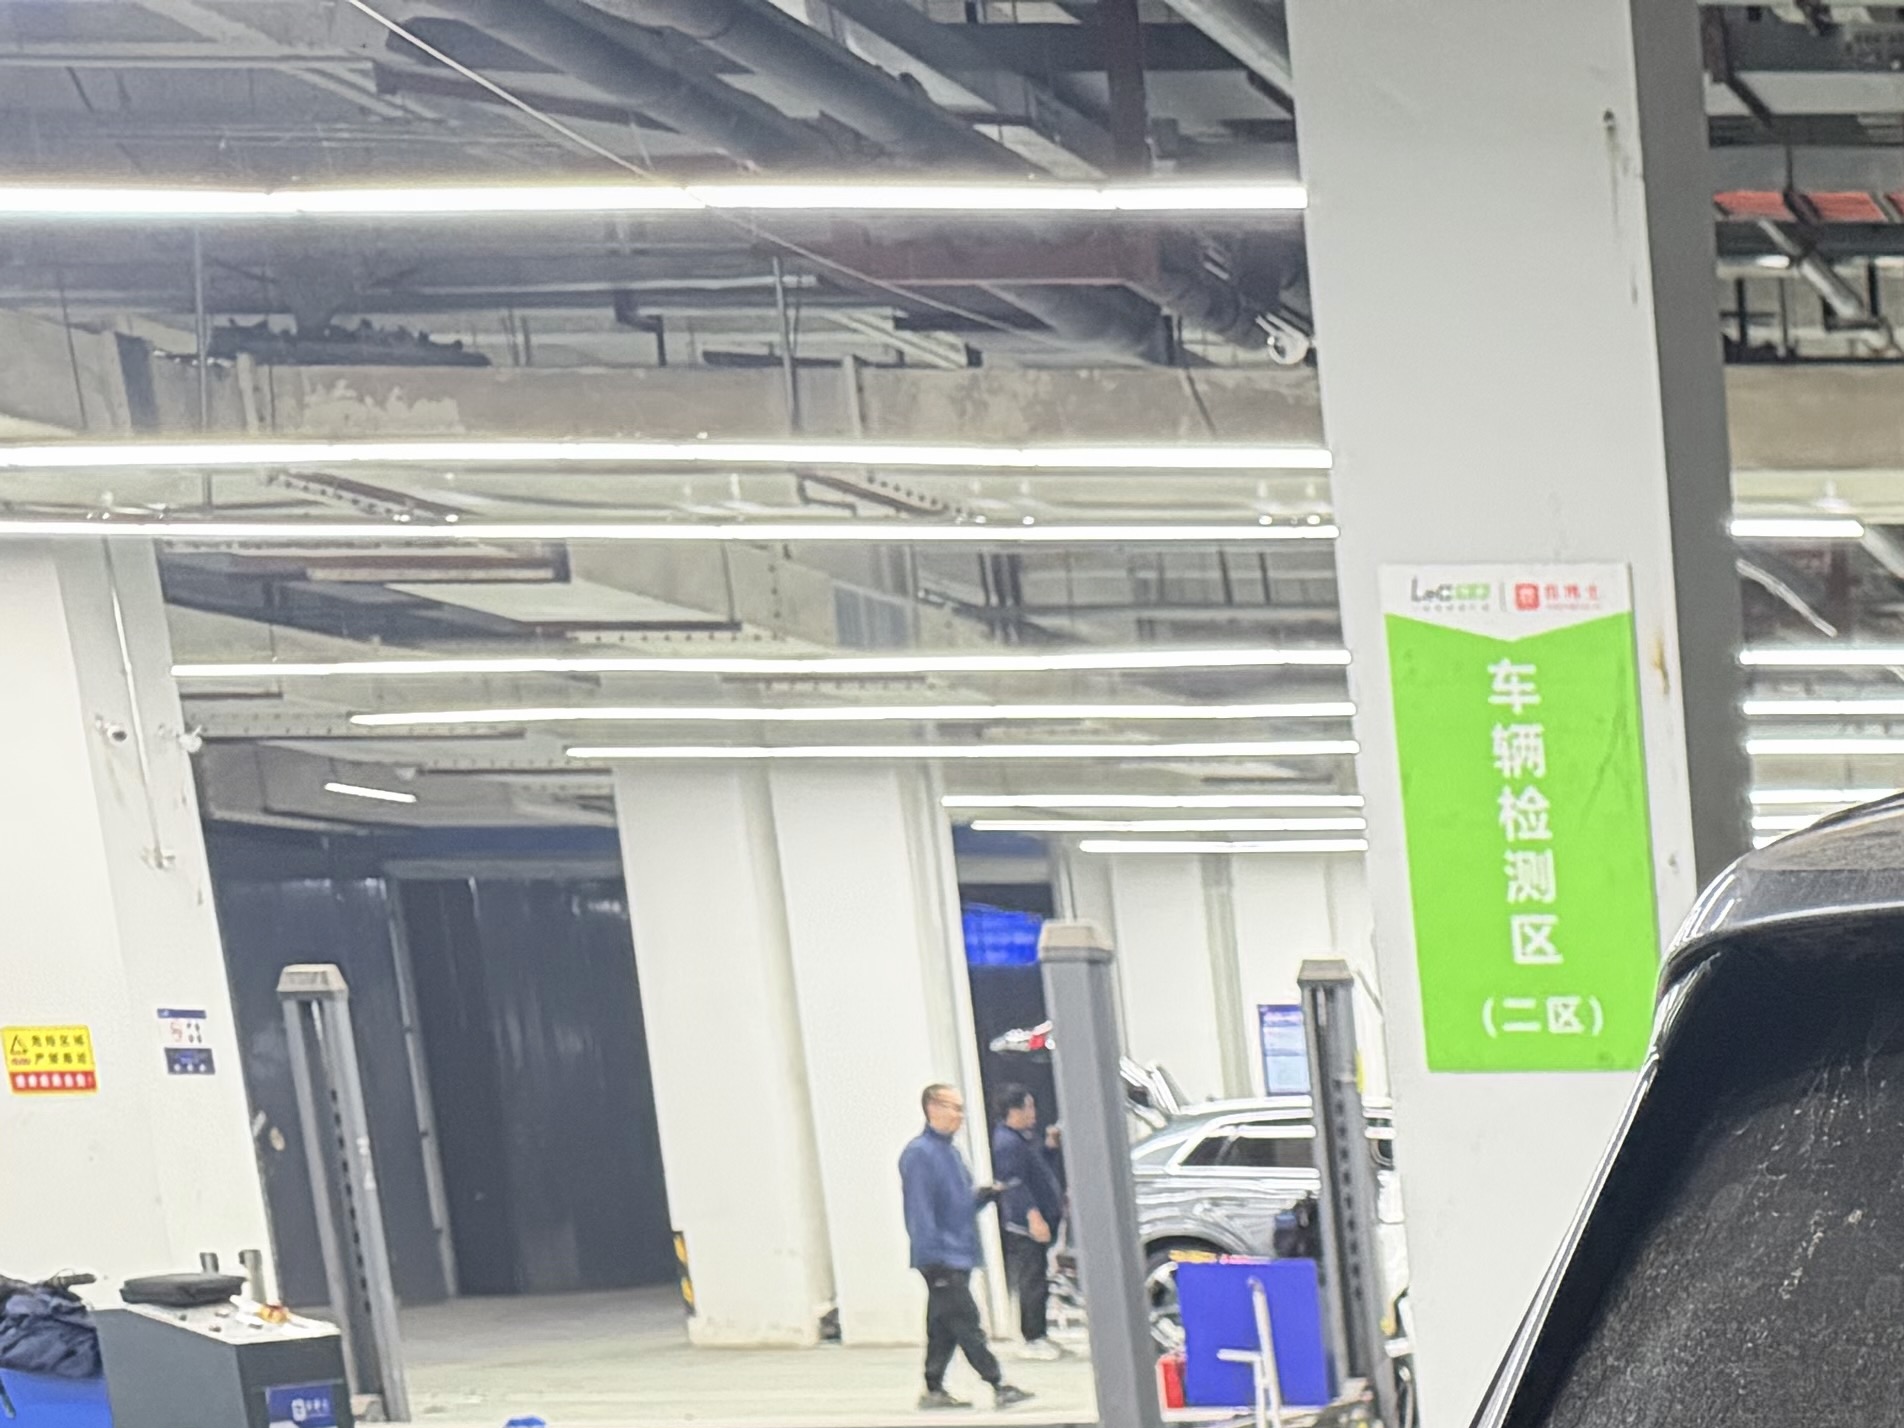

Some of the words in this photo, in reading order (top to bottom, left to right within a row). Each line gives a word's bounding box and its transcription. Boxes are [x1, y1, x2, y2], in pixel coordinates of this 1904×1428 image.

[1486, 657, 1565, 965] 车辆检测区
